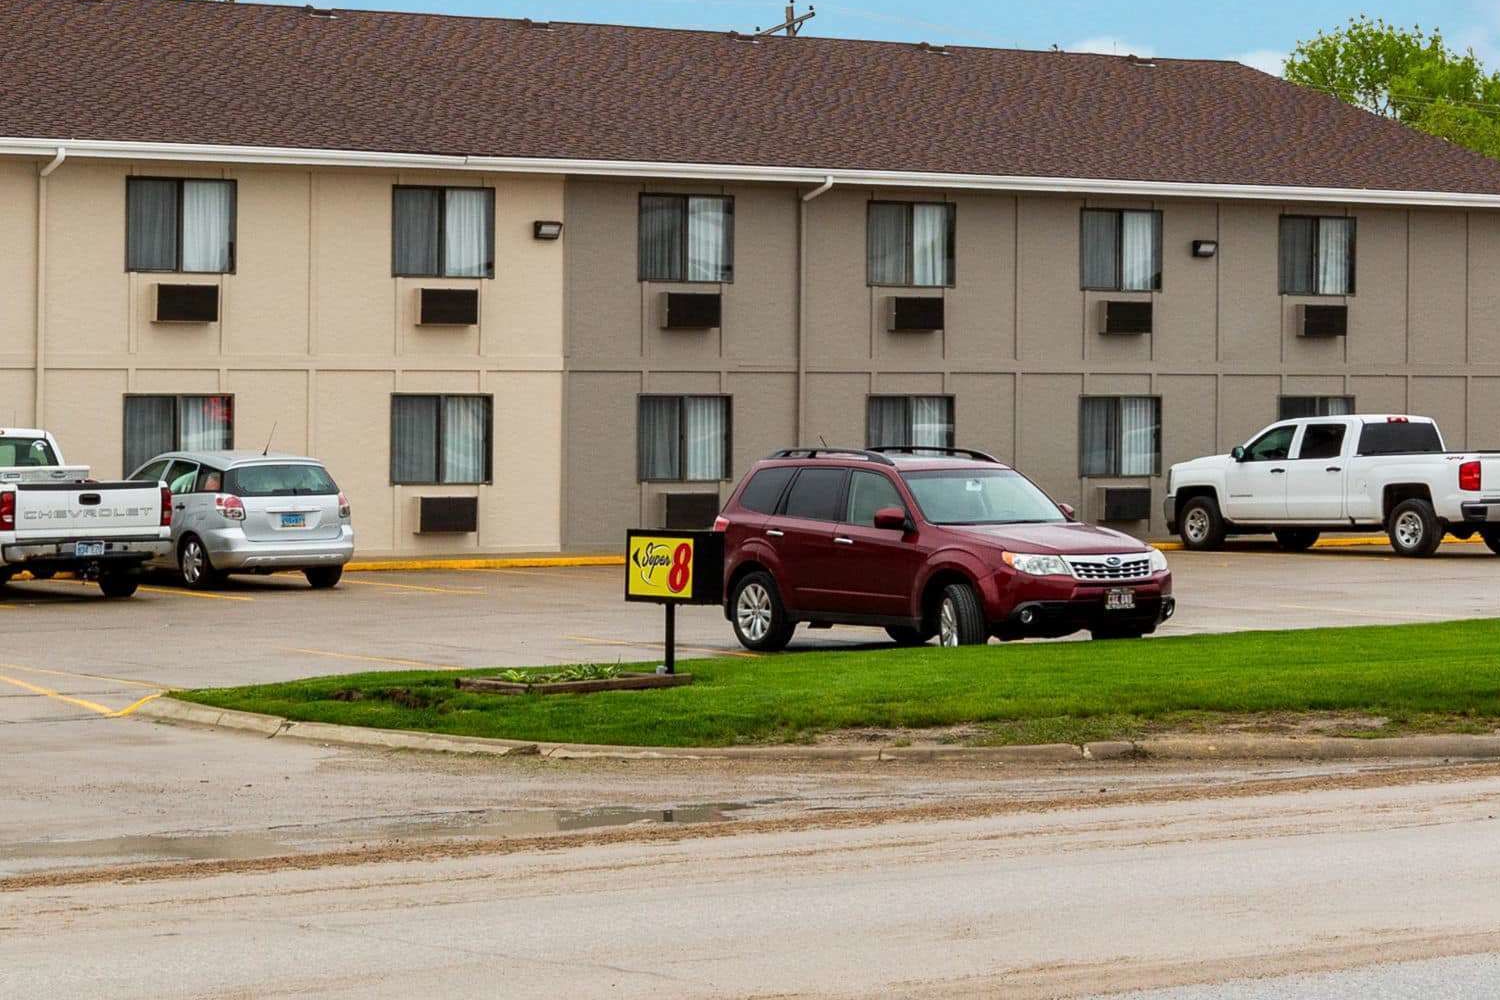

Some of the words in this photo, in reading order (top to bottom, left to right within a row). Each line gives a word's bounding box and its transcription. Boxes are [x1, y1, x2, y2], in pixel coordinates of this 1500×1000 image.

[23, 507, 153, 520] CHEVROLET
[641, 541, 671, 579] Super
[667, 542, 692, 594] 8
